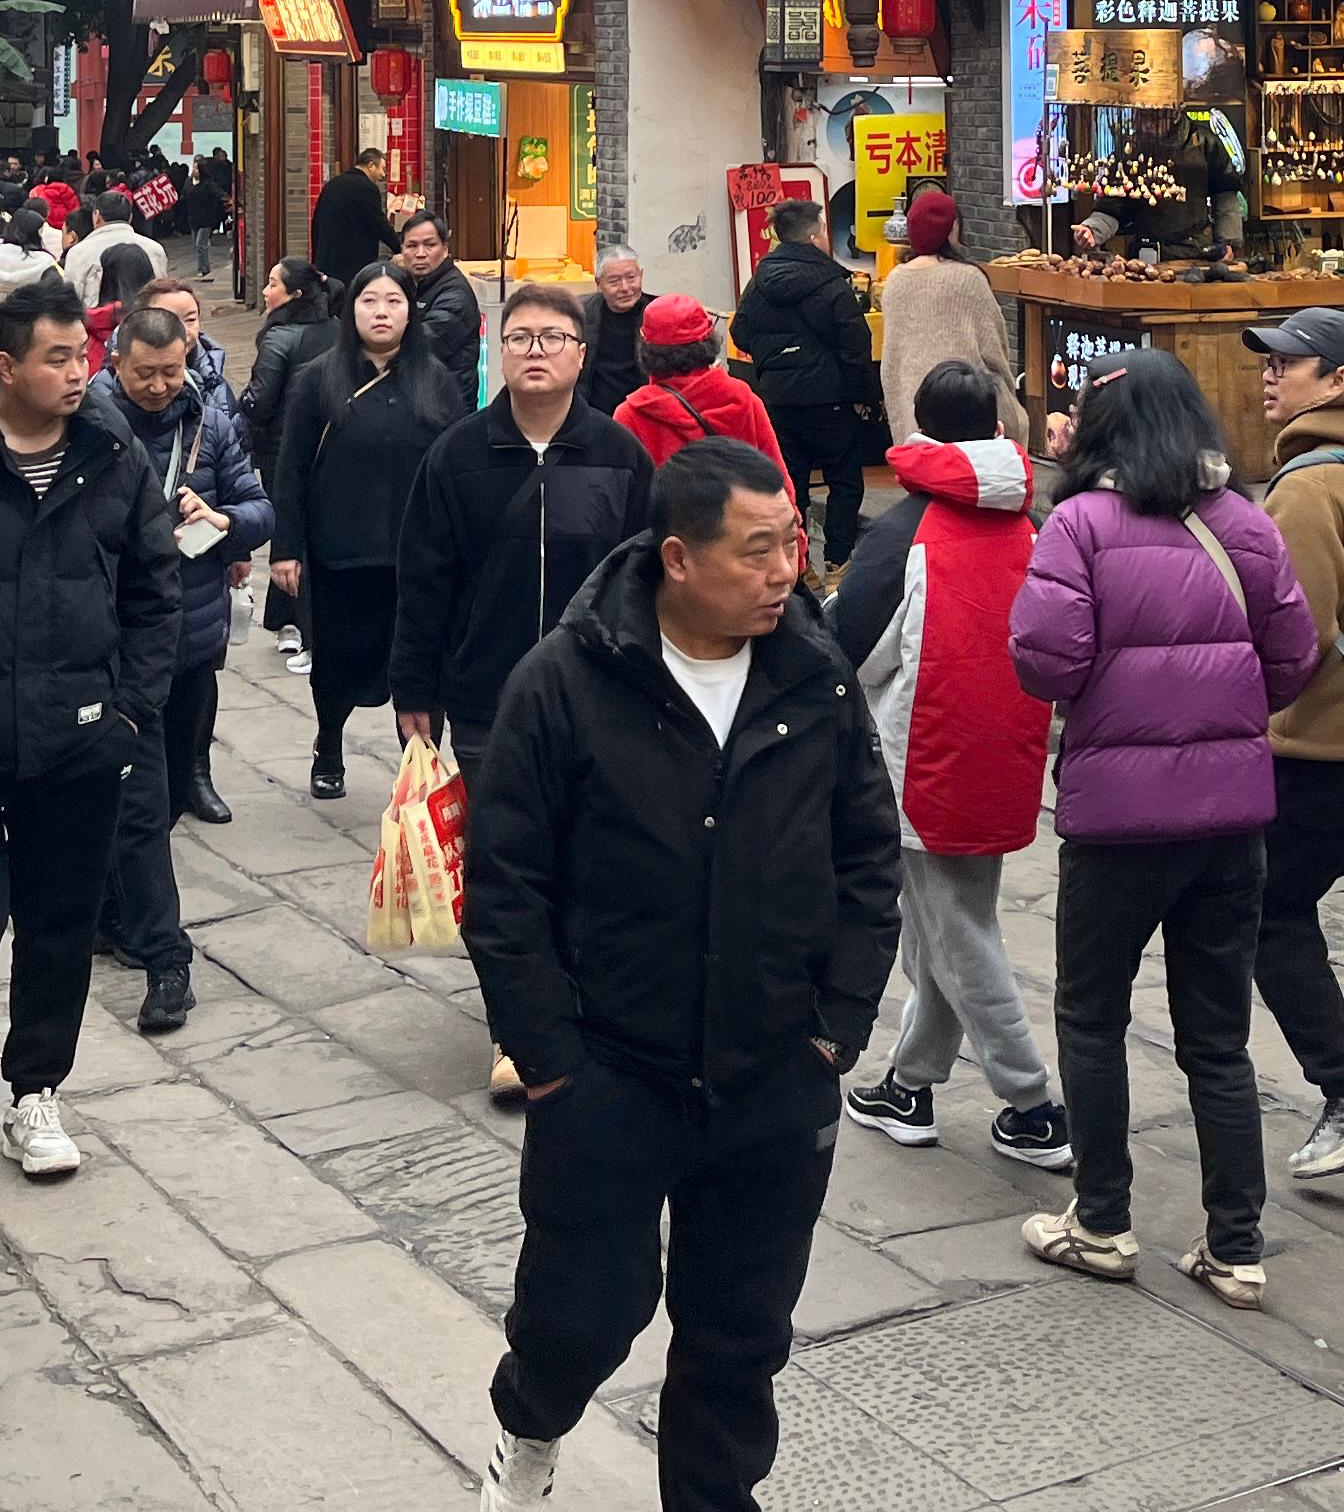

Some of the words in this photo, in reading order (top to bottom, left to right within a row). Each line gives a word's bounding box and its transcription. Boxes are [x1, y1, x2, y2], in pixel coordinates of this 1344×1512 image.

[1095, 0, 1241, 24] 彩色释迦菩提果
[1071, 49, 1151, 88] 菩提果
[865, 131, 946, 175] 亏本清
[133, 175, 179, 221] 豆花5元
